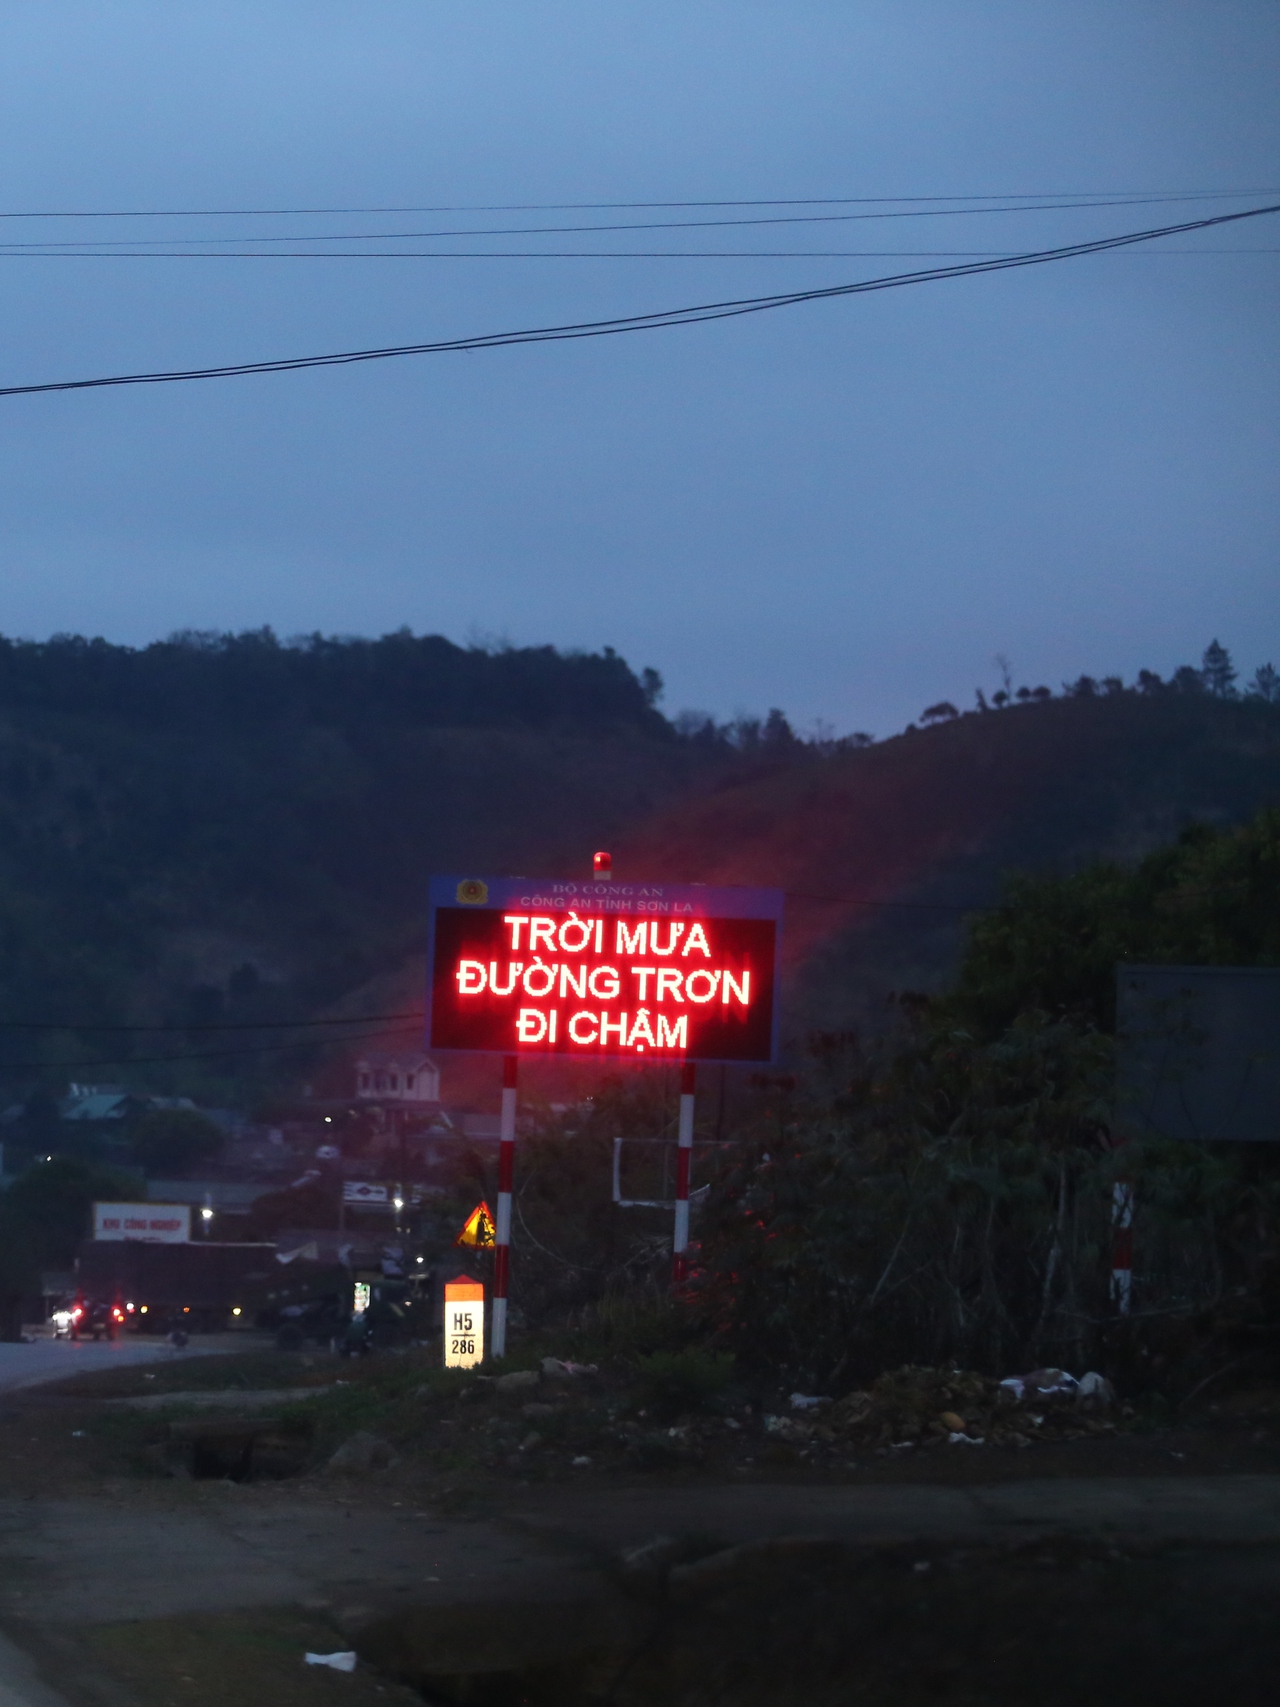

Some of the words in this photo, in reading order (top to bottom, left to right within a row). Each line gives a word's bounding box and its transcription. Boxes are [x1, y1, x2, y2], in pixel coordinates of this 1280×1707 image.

[552, 883, 577, 895] BỘ
[582, 884, 633, 896] CÔNG
[638, 887, 664, 897] AN
[520, 894, 565, 908] CÔNG
[570, 898, 591, 909] AN
[637, 900, 669, 912] SƠN
[674, 902, 693, 913] LA
[504, 912, 603, 954] TRỜI
[616, 920, 711, 958] MƯA
[456, 956, 620, 1000] ĐƯỜNG
[631, 966, 750, 1005] TRƠN
[515, 1008, 557, 1043] ĐI
[568, 1007, 688, 1052] CHẬM
[453, 1313, 473, 1331] H5
[451, 1339, 475, 1354] 286
